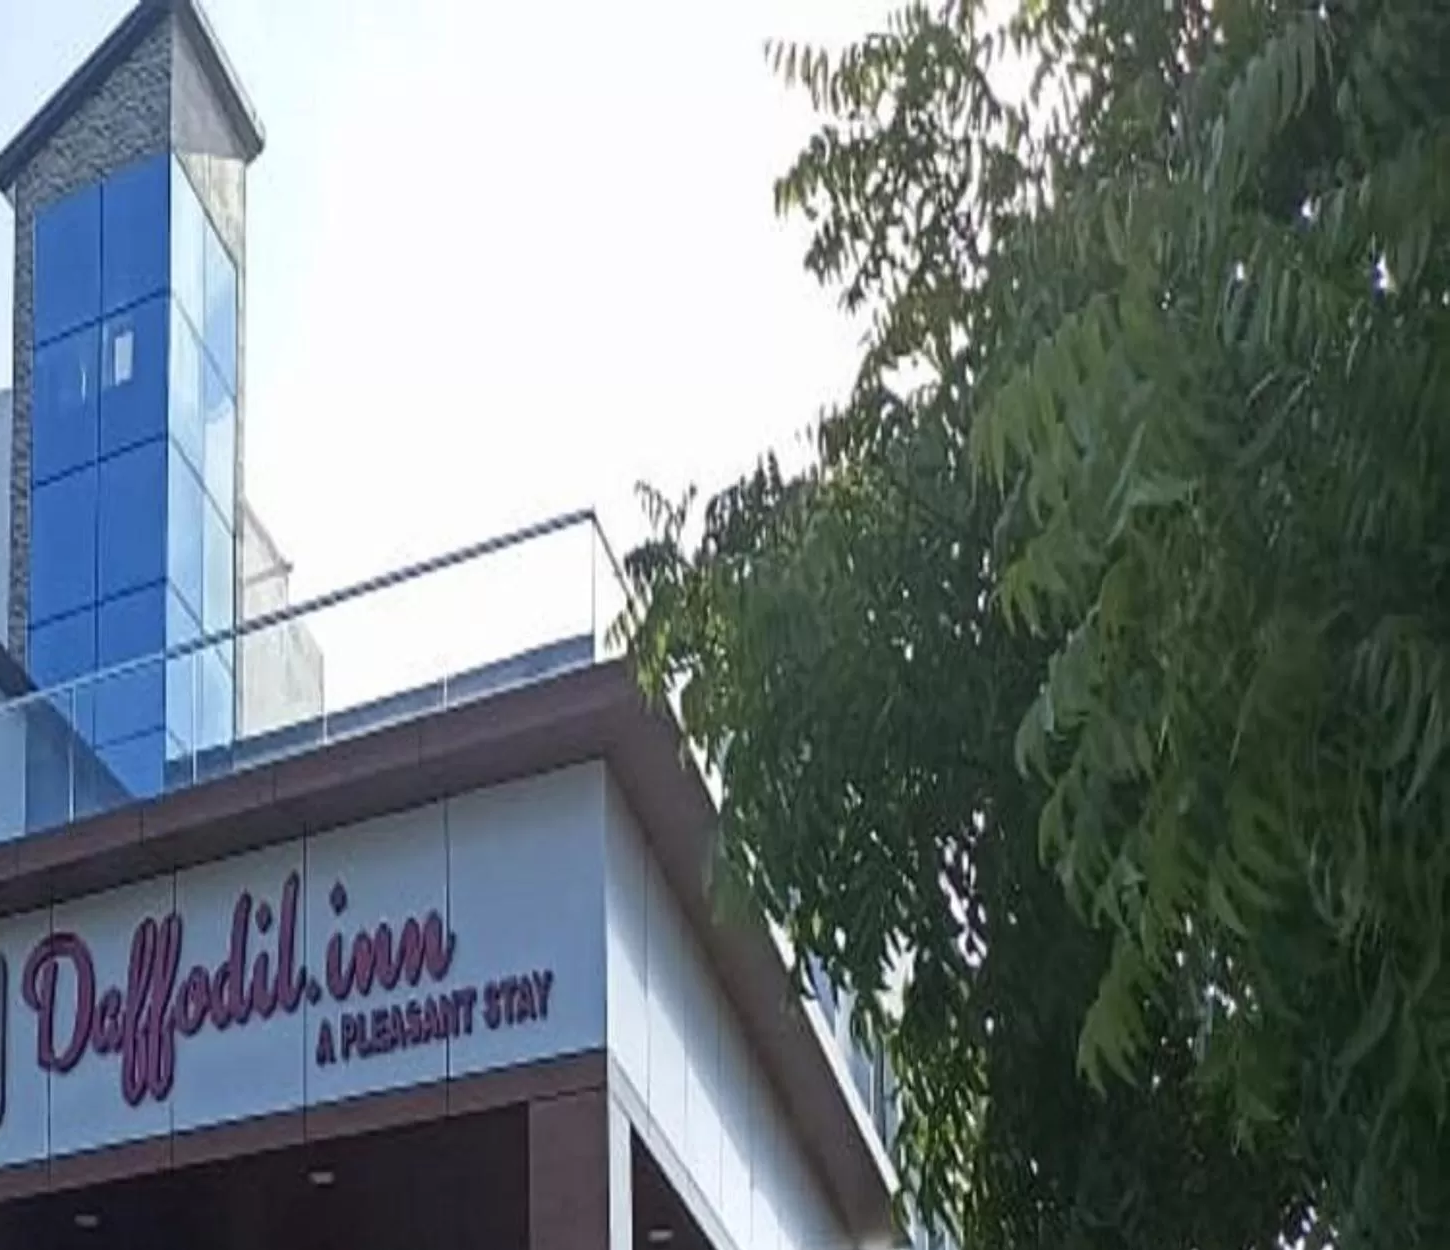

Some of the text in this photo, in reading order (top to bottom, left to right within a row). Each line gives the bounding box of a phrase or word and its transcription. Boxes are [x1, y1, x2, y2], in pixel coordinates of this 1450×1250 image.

[316, 969, 553, 1066] A PLEASANT STAY
